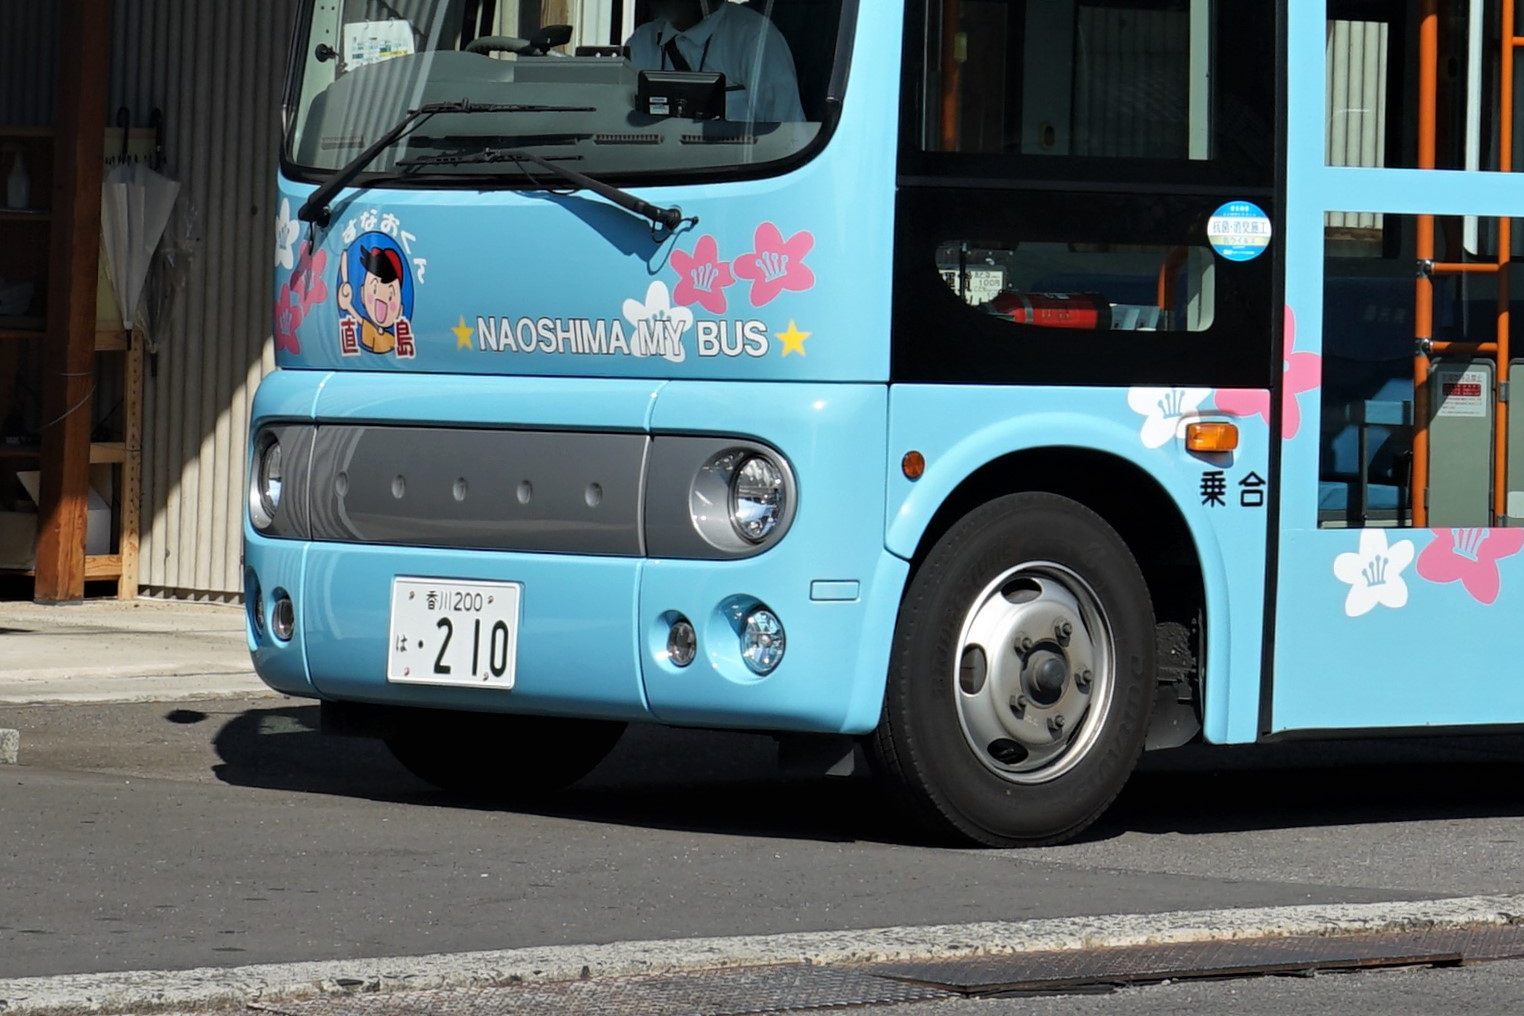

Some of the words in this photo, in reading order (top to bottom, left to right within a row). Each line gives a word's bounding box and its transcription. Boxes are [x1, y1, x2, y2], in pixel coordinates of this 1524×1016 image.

[342, 209, 427, 284] すなおくん
[476, 316, 631, 355] NAOSHIMA
[637, 319, 687, 356] MY
[697, 320, 770, 358] BUS
[1200, 470, 1267, 508] 乗合
[396, 634, 408, 653] は
